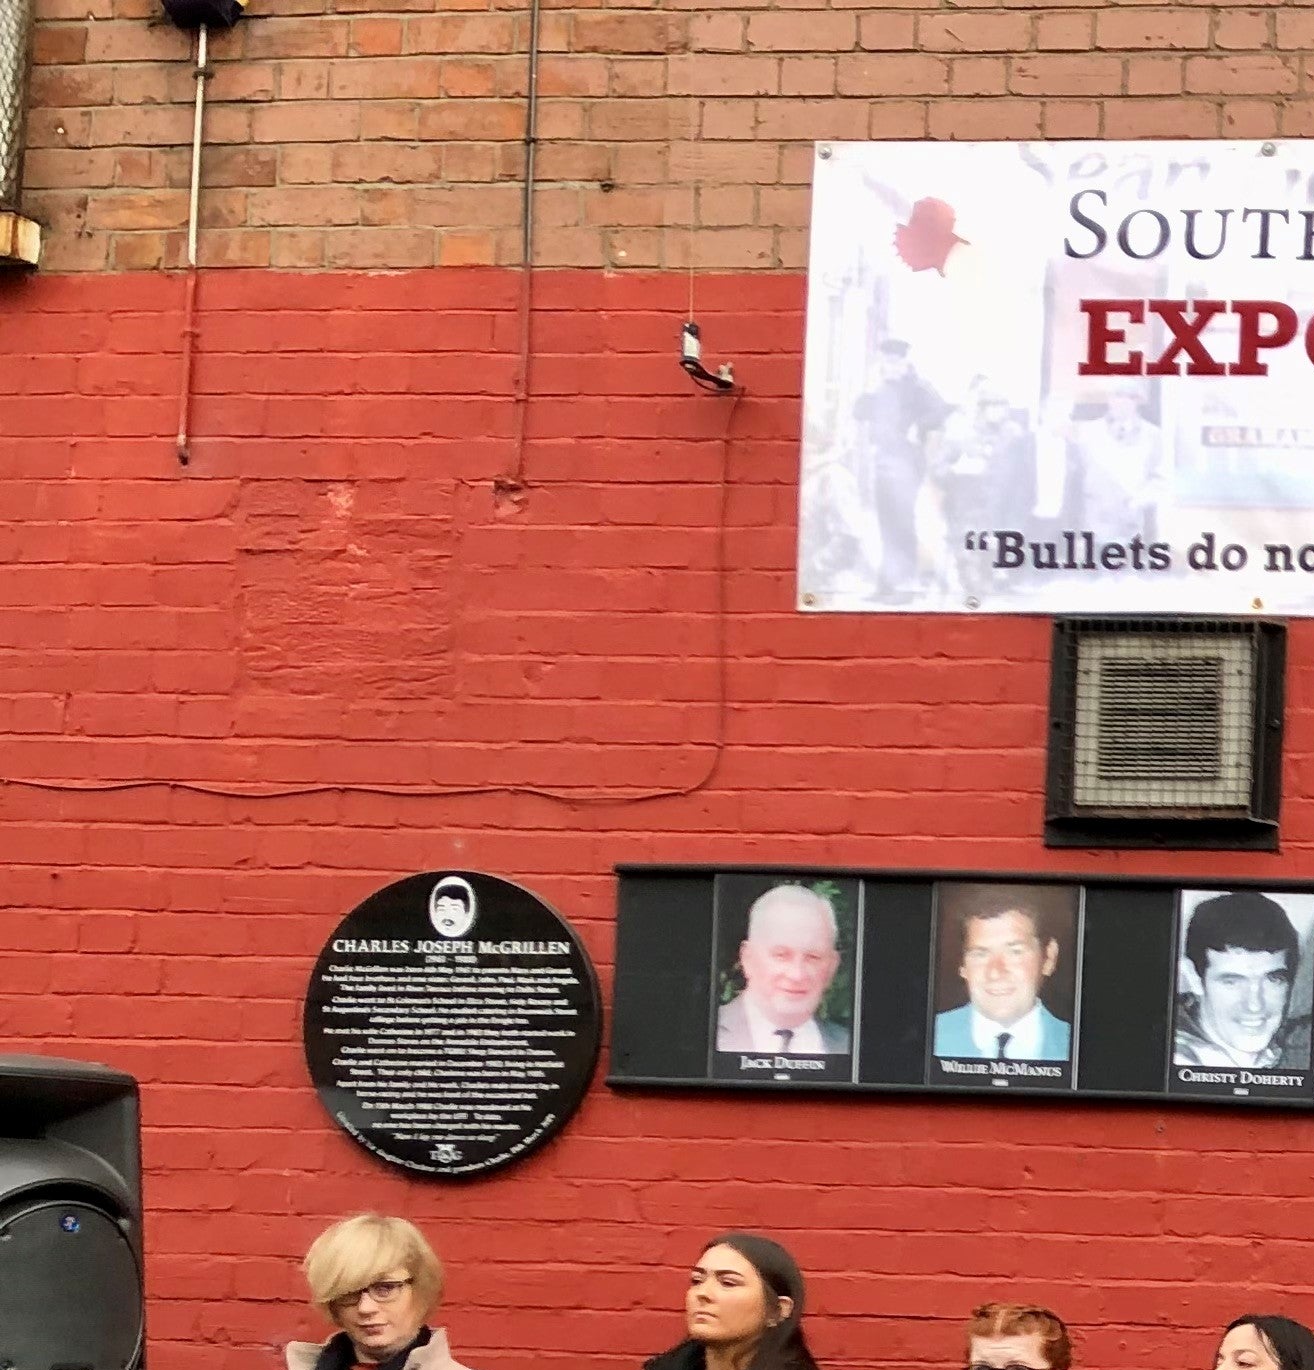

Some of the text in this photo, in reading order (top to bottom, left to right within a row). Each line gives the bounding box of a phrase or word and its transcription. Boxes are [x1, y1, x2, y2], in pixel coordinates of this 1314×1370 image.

[965, 530, 1171, 571] “Bullets
[1187, 532, 1247, 571] do
[332, 939, 409, 953] CHARLES
[413, 940, 473, 954] JOSEPH
[1178, 1068, 1304, 1086] CHRISTY DOHERTY
